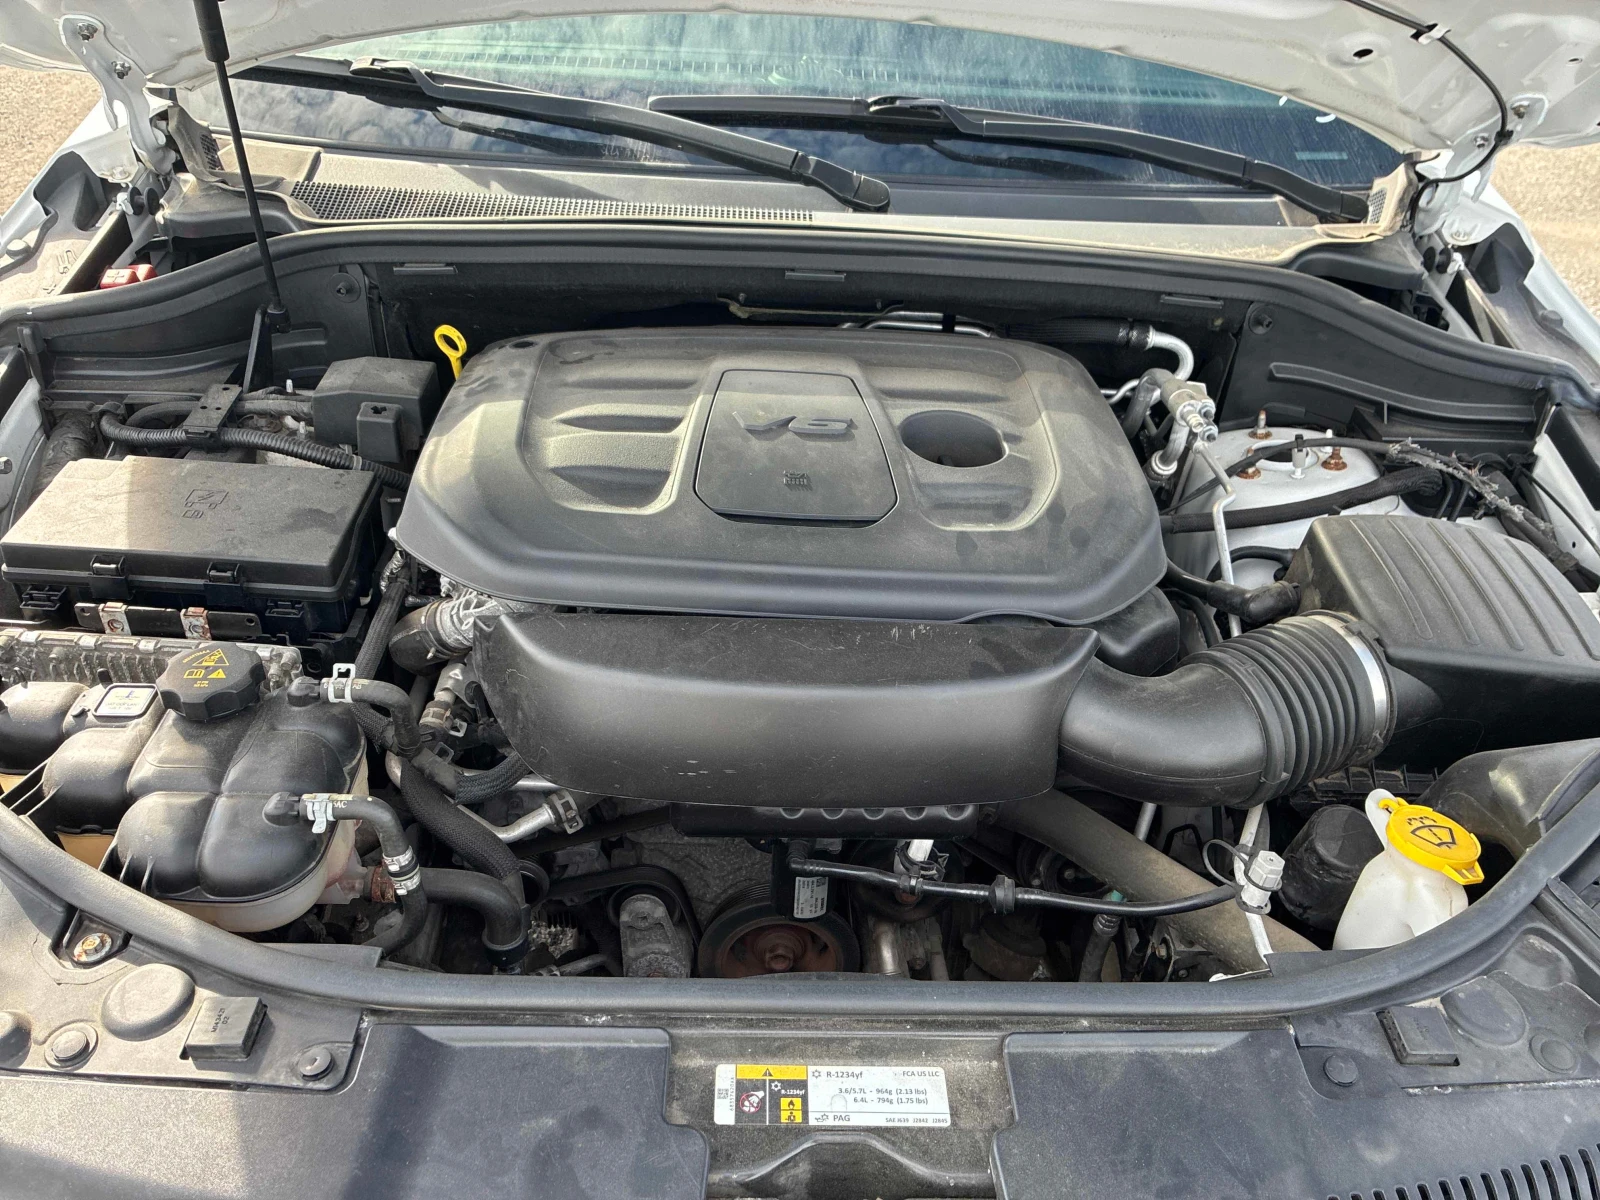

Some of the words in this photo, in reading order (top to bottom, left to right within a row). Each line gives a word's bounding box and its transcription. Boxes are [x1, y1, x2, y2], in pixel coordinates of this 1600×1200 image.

[826, 1071, 863, 1079] R-1234yf
[838, 1087, 867, 1095] 3.6/5.7L
[875, 1088, 893, 1096] 964g
[877, 1097, 894, 1105] 794g
[896, 1097, 914, 1105] (1.75
[915, 1097, 928, 1105] lbs)
[833, 1114, 850, 1122] PAG
